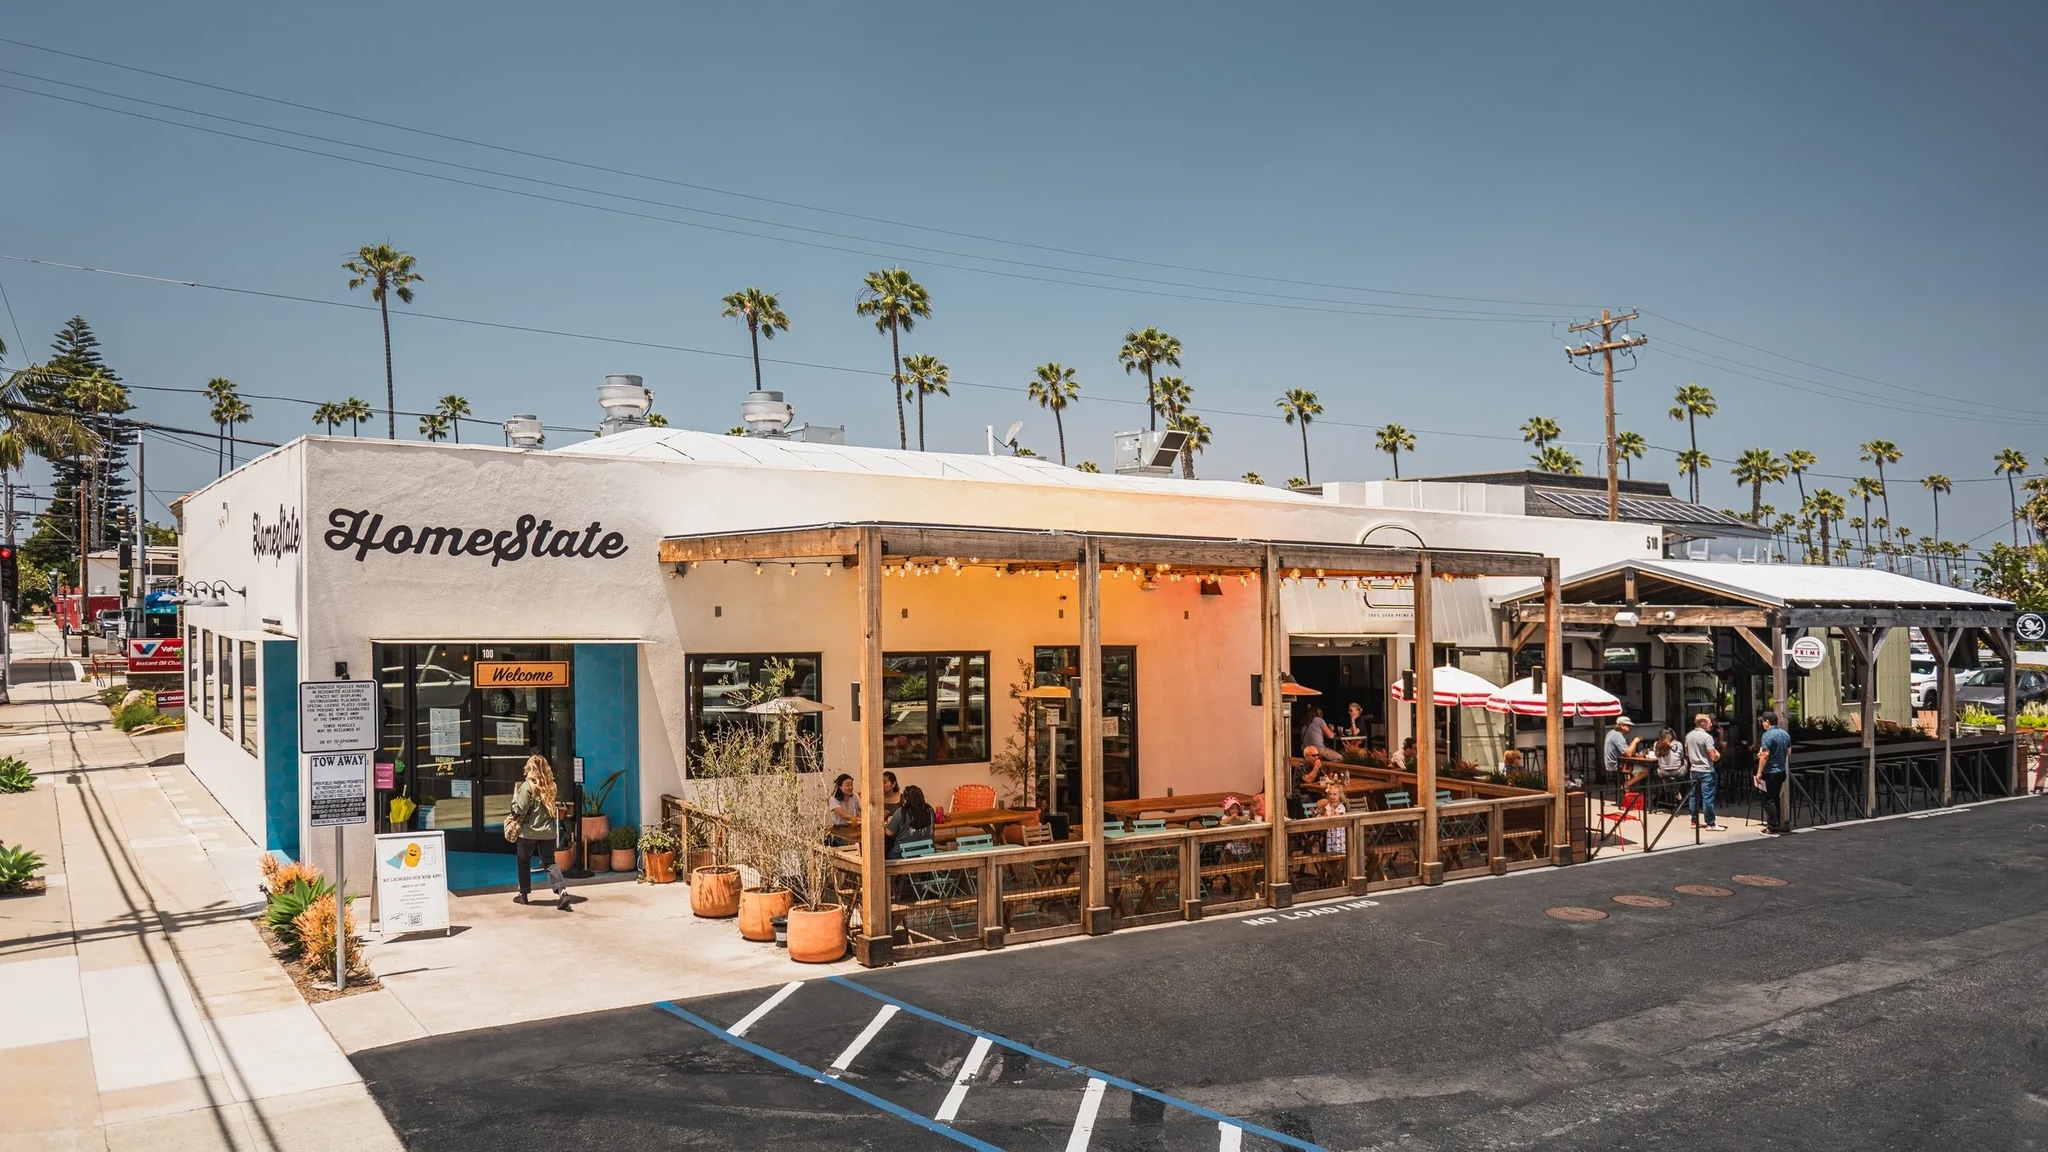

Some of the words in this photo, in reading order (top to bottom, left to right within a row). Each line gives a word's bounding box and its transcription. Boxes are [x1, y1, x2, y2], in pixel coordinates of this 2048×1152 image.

[253, 503, 301, 568] HomeState
[324, 508, 628, 567] HomeState
[482, 649, 494, 658] 100
[492, 667, 554, 682] Welcome
[313, 756, 336, 767] TOW
[337, 756, 364, 766] AWAY
[1242, 916, 1277, 926] NO
[1280, 900, 1380, 920] LOADING
